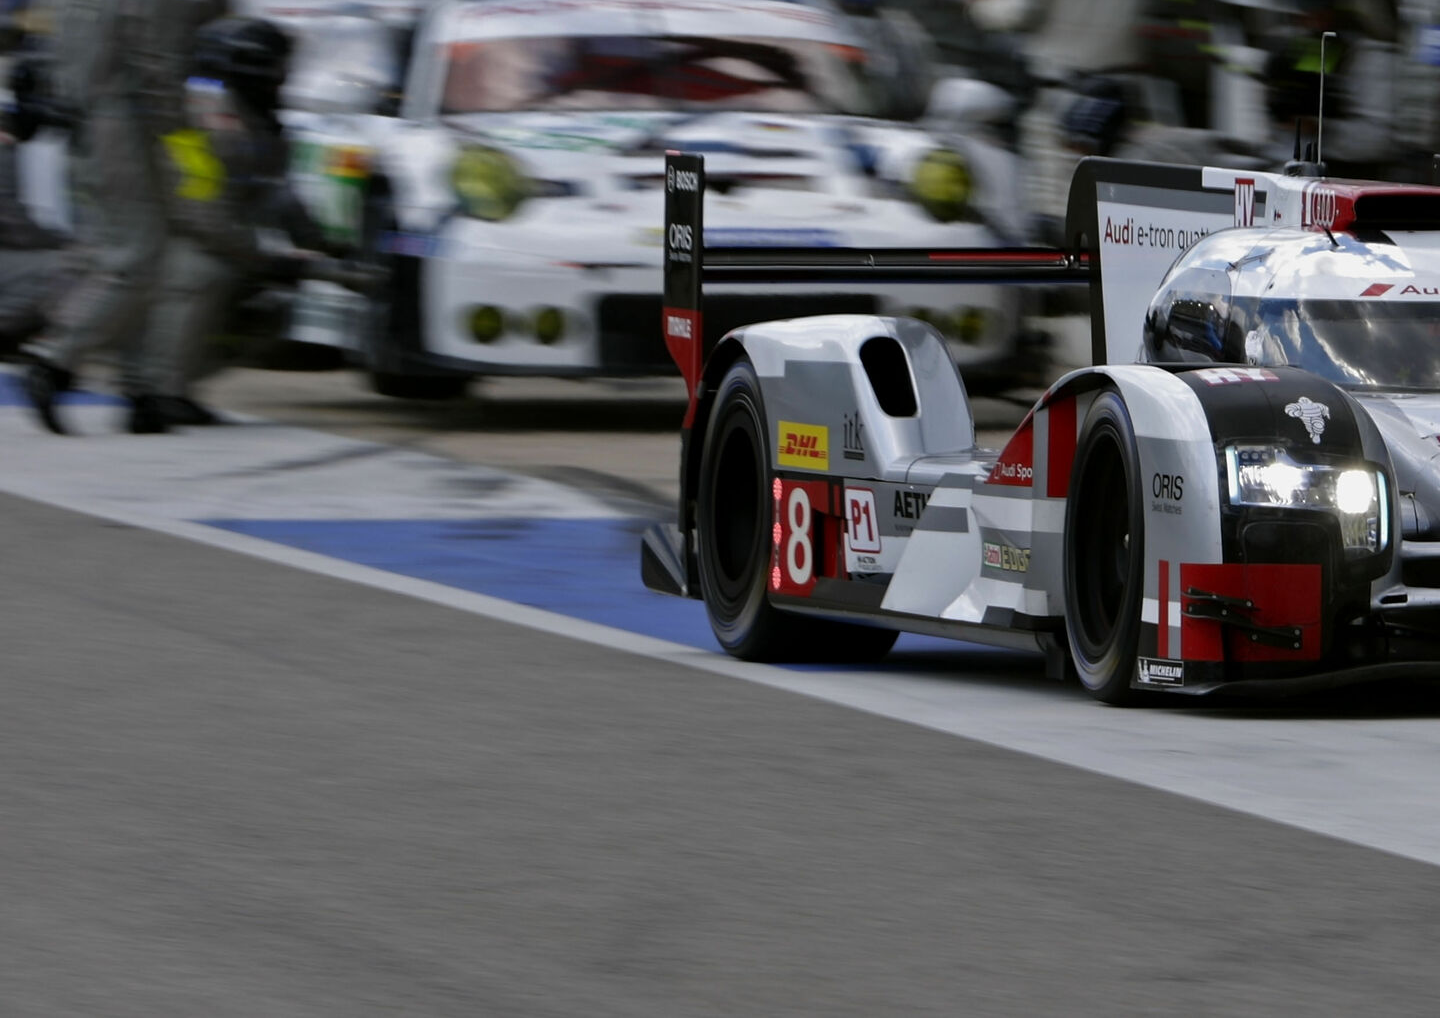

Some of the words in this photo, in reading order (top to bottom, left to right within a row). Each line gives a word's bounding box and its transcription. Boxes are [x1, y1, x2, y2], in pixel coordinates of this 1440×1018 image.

[675, 170, 699, 191] BOSCH
[669, 223, 693, 251] ORIS
[1104, 215, 1134, 245] Audi
[1137, 223, 1174, 249] e-tron
[1177, 227, 1209, 252] qua
[843, 411, 865, 452] itk
[780, 433, 827, 459] DHL
[1016, 463, 1033, 482] Spo
[1153, 473, 1184, 501] ORIS
[850, 499, 874, 542] P1
[787, 487, 812, 585] 8
